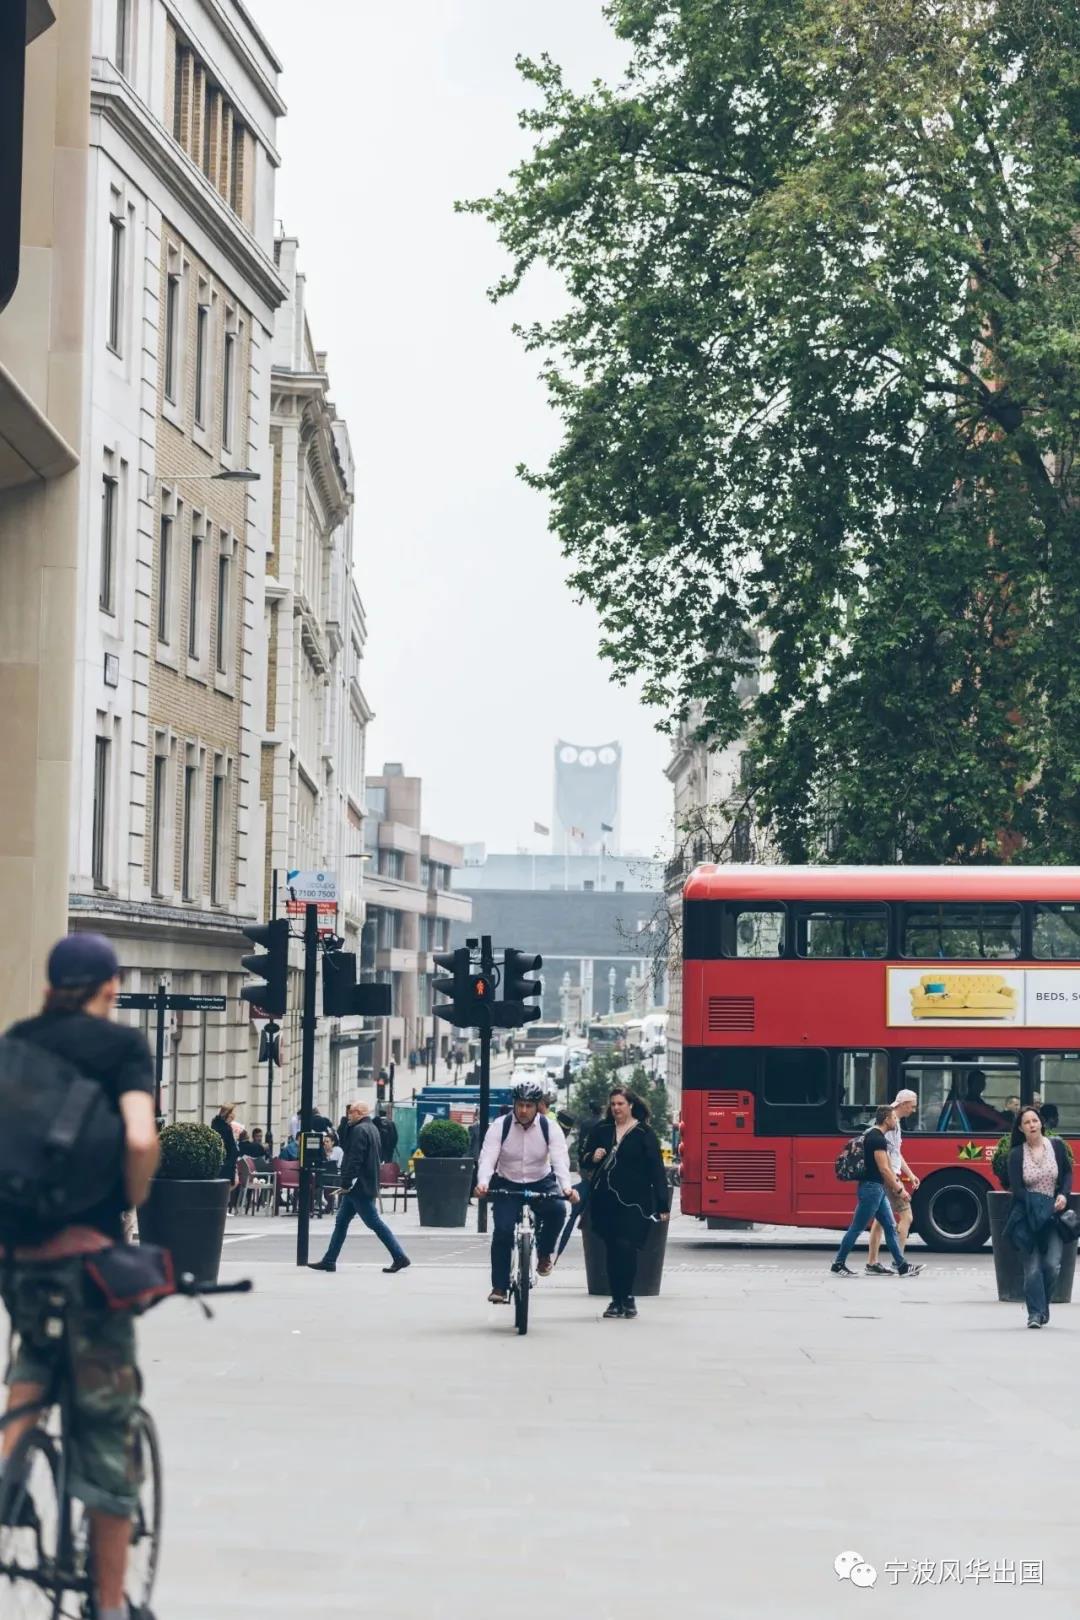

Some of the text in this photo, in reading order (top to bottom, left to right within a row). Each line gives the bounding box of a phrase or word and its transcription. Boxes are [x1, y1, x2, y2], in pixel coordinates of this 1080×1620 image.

[299, 889, 316, 897] 7100
[318, 890, 336, 898] 7500
[1036, 992, 1080, 1002] BEDS, S
